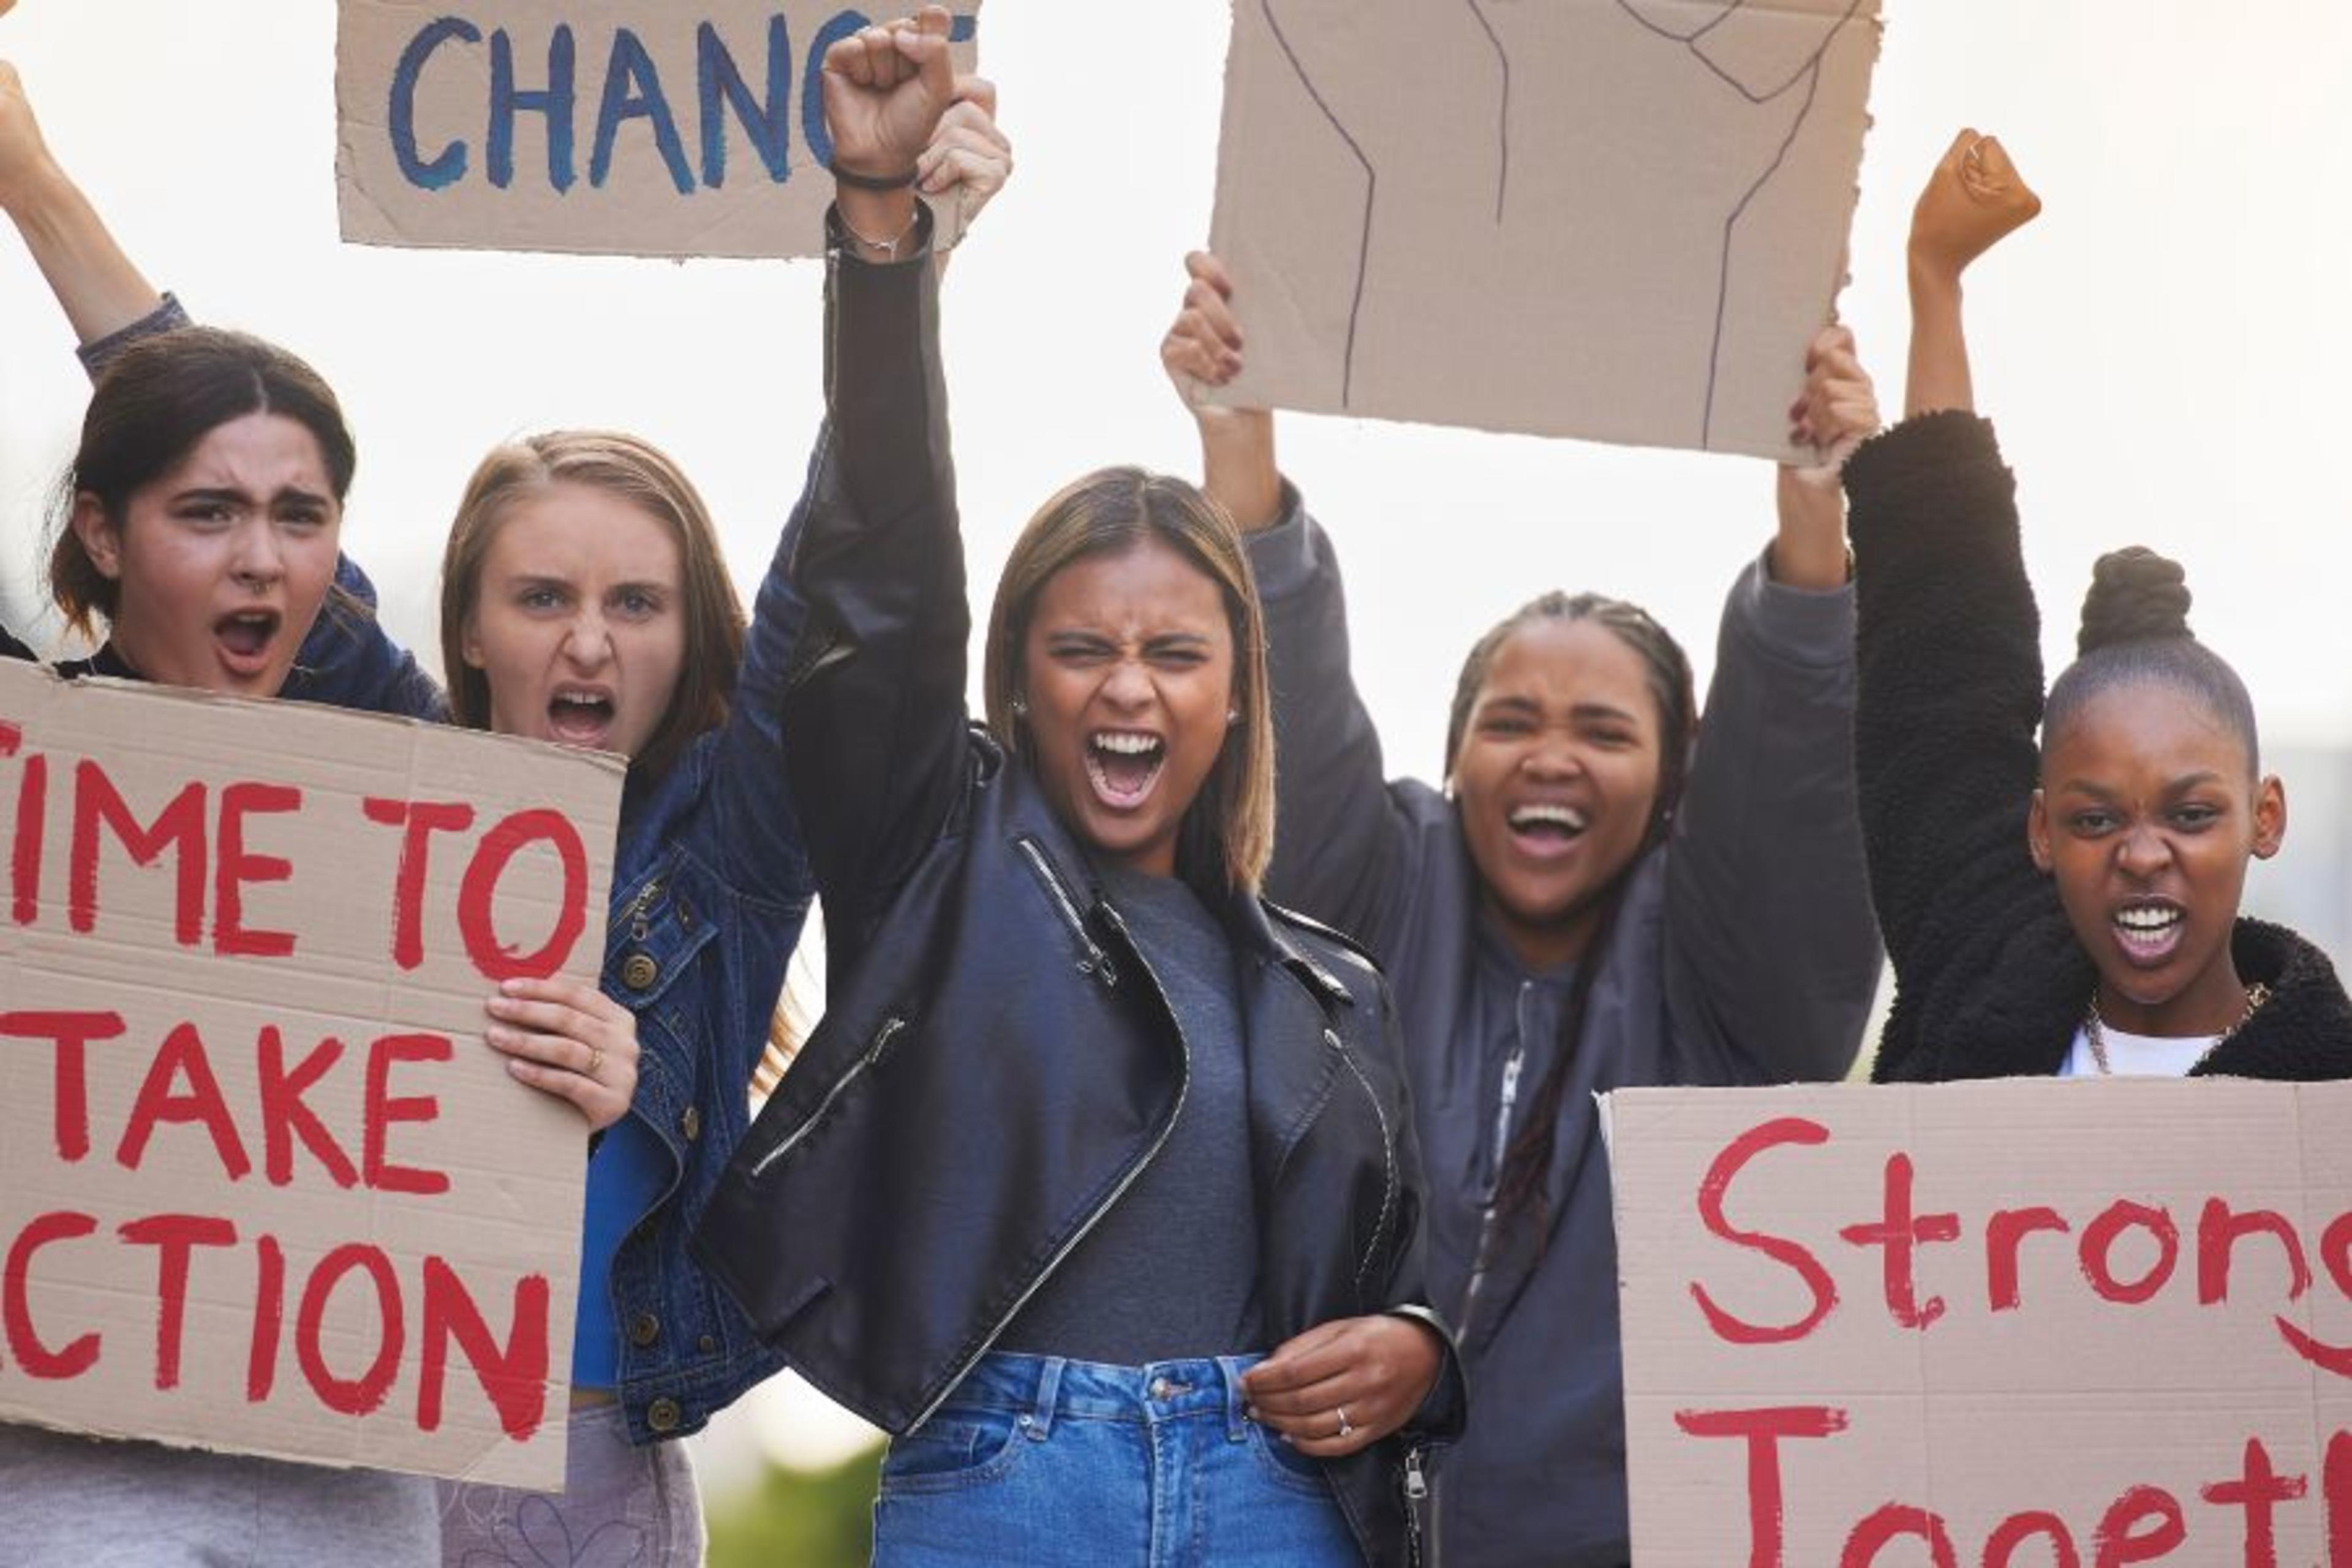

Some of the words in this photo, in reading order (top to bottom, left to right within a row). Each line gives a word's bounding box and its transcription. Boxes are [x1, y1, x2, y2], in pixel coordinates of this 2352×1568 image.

[388, 8, 976, 195] CHAN
[0, 720, 302, 958] IME
[363, 794, 587, 982] TO
[0, 1010, 454, 1195] TAKE
[0, 1210, 550, 1442] CTION
